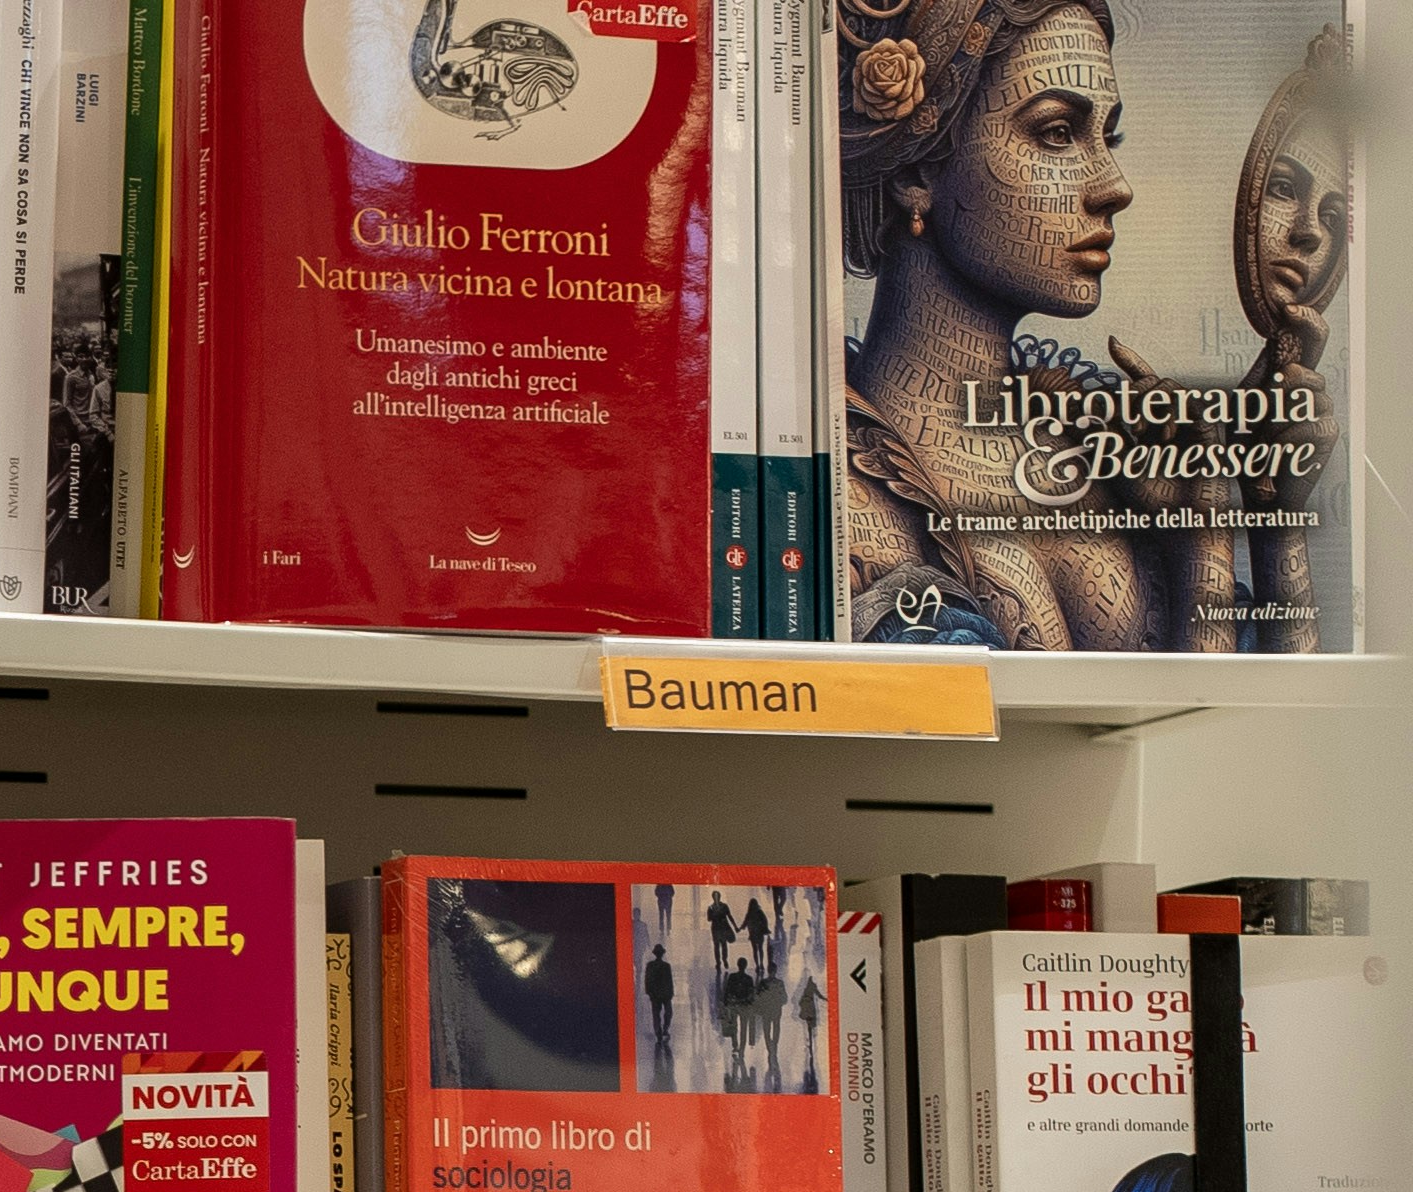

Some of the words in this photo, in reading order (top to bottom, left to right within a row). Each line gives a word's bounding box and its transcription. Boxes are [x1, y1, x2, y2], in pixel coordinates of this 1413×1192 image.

[21, 60, 33, 84] CHI
[19, 88, 31, 128] VINCE
[18, 133, 31, 164] NON
[17, 168, 29, 186] SA
[16, 190, 28, 226] COSA
[15, 230, 27, 244] SI
[351, 206, 471, 254] Giulio
[479, 212, 611, 259] Ferroni
[14, 249, 27, 295] PERDE
[296, 256, 410, 295] Natura
[416, 260, 513, 300] vicina
[520, 276, 539, 300] e
[545, 267, 664, 306] lontana
[355, 329, 486, 357] Umanesimo
[491, 339, 505, 357] e
[510, 335, 608, 363] ambiente
[386, 361, 440, 391] dagli
[444, 364, 522, 390] antichi
[526, 367, 578, 395] greci
[352, 392, 507, 424] all'intelligenza
[511, 398, 610, 425] artificiale
[961, 372, 1320, 435] Libroterapia
[1083, 430, 1322, 482] Benessere
[927, 512, 954, 532] Le
[956, 514, 1018, 532] trame
[1021, 509, 1151, 534] archetipiche
[1155, 508, 1206, 529] della
[1210, 507, 1320, 529] letteratura
[1190, 602, 1248, 622] Nuova
[1250, 602, 1320, 621] edizione
[622, 666, 819, 714] Bauman
[29, 859, 209, 887] JEFFRIES
[21, 905, 245, 956] SEMPRE,
[1022, 953, 1092, 972] Caitlin
[1099, 953, 1191, 978] Doughty
[1023, 981, 1050, 1012] Il
[1061, 981, 1134, 1013] mio
[53, 1032, 168, 1051] DIVENTATI
[1025, 1021, 1075, 1053] mi
[131, 1075, 255, 1110] NOVITÀ
[1028, 1063, 1076, 1103] gli
[131, 1132, 174, 1149] -5%
[177, 1134, 218, 1149] SOLO
[221, 1134, 257, 1149] CON
[433, 1118, 450, 1147] Il
[461, 1119, 542, 1154] primo
[551, 1120, 615, 1150] libro
[624, 1121, 652, 1151] di
[131, 1156, 258, 1182] CartaEffe
